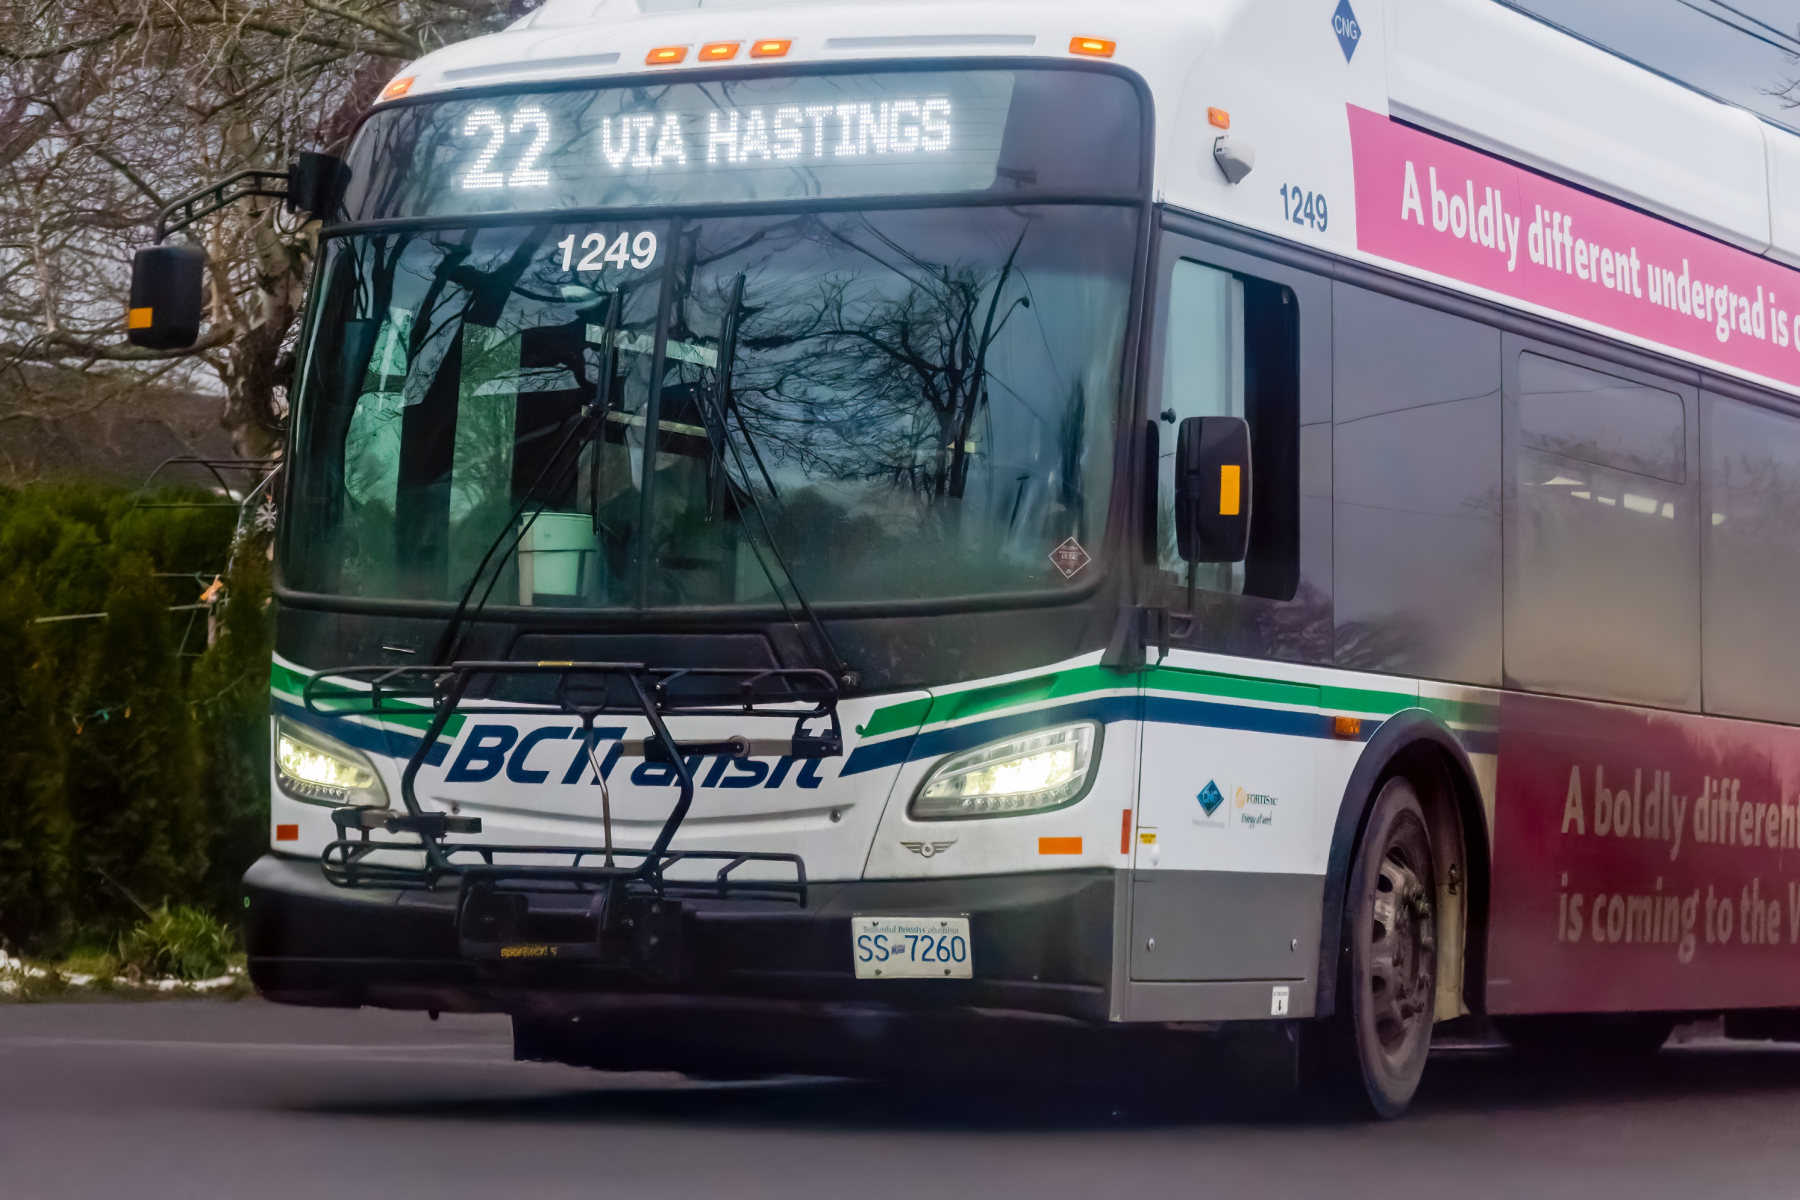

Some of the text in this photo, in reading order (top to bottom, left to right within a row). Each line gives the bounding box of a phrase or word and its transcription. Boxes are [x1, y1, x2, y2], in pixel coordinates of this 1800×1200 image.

[1334, 15, 1358, 40] CNG
[463, 99, 951, 189] 22 VIA HASTINGS
[1280, 182, 1328, 233] 1249
[557, 231, 657, 272] 1249
[1401, 160, 1425, 227] A
[1429, 166, 1520, 273] boldly
[1528, 204, 1642, 299] different
[1647, 258, 1766, 343] undergrad
[1769, 291, 1789, 348] is
[1561, 765, 1585, 835] A
[1594, 764, 1687, 862] boldly
[858, 934, 966, 962] SS 7260
[1558, 873, 1584, 942] is
[1591, 876, 1699, 964] coming
[1705, 884, 1733, 944] to
[1740, 877, 1781, 944] the
